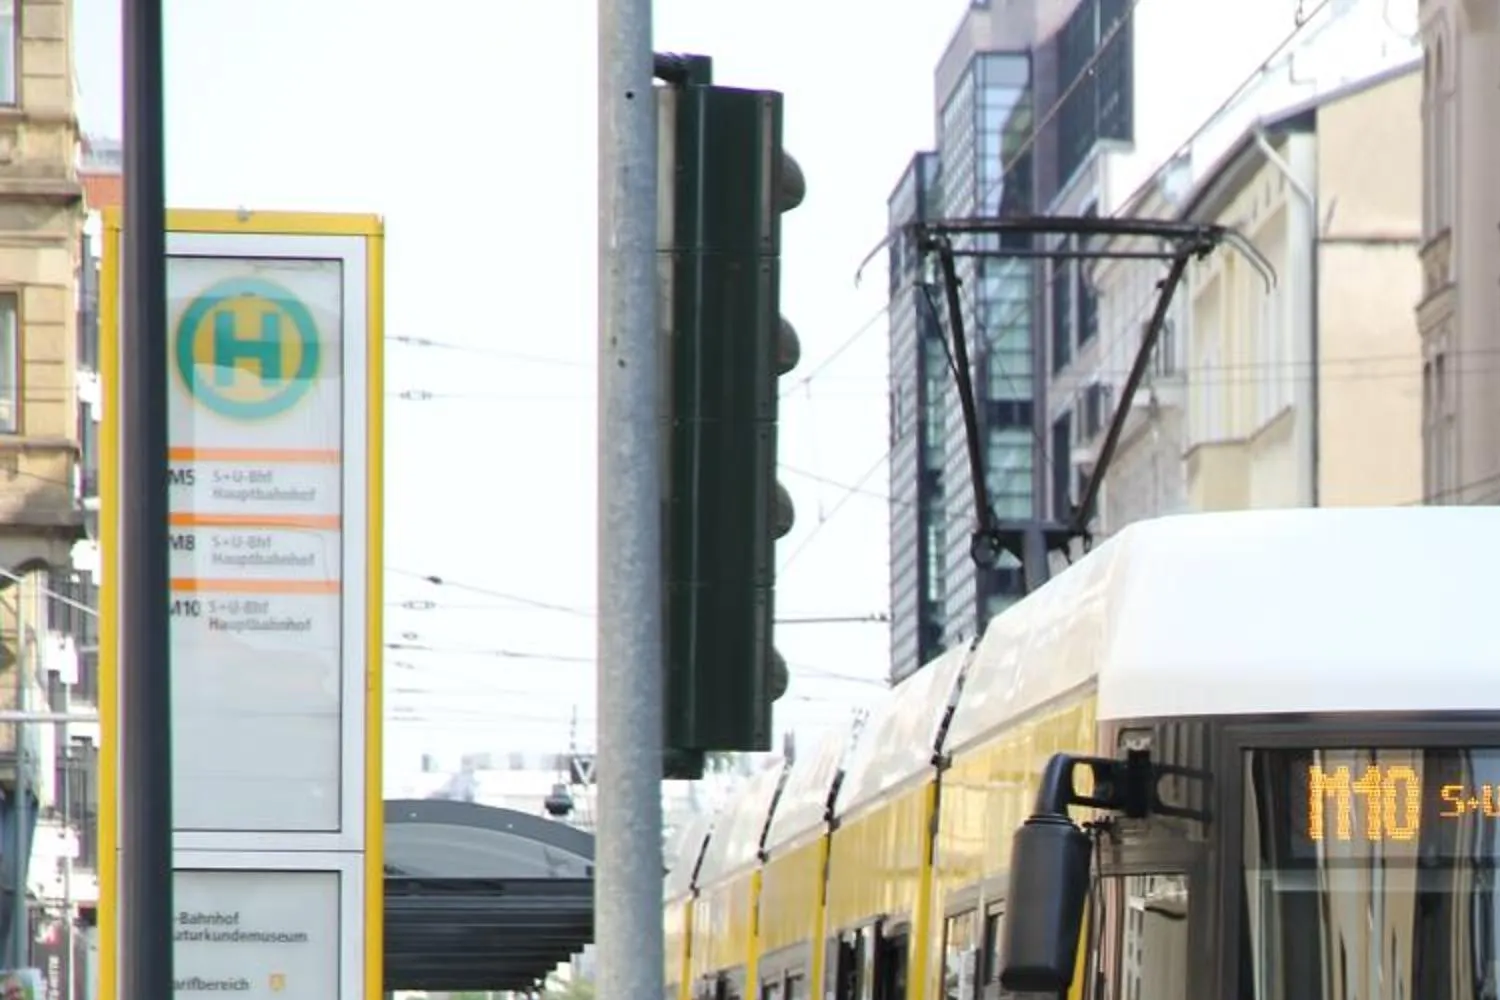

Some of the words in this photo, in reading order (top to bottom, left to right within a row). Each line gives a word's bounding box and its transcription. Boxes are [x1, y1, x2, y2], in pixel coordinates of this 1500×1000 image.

[212, 310, 283, 388] H
[1309, 765, 1420, 841] M10
[174, 911, 240, 925] -Bahnhof
[173, 928, 308, 943] aturkundemuseum
[172, 976, 250, 991] arifbereich
